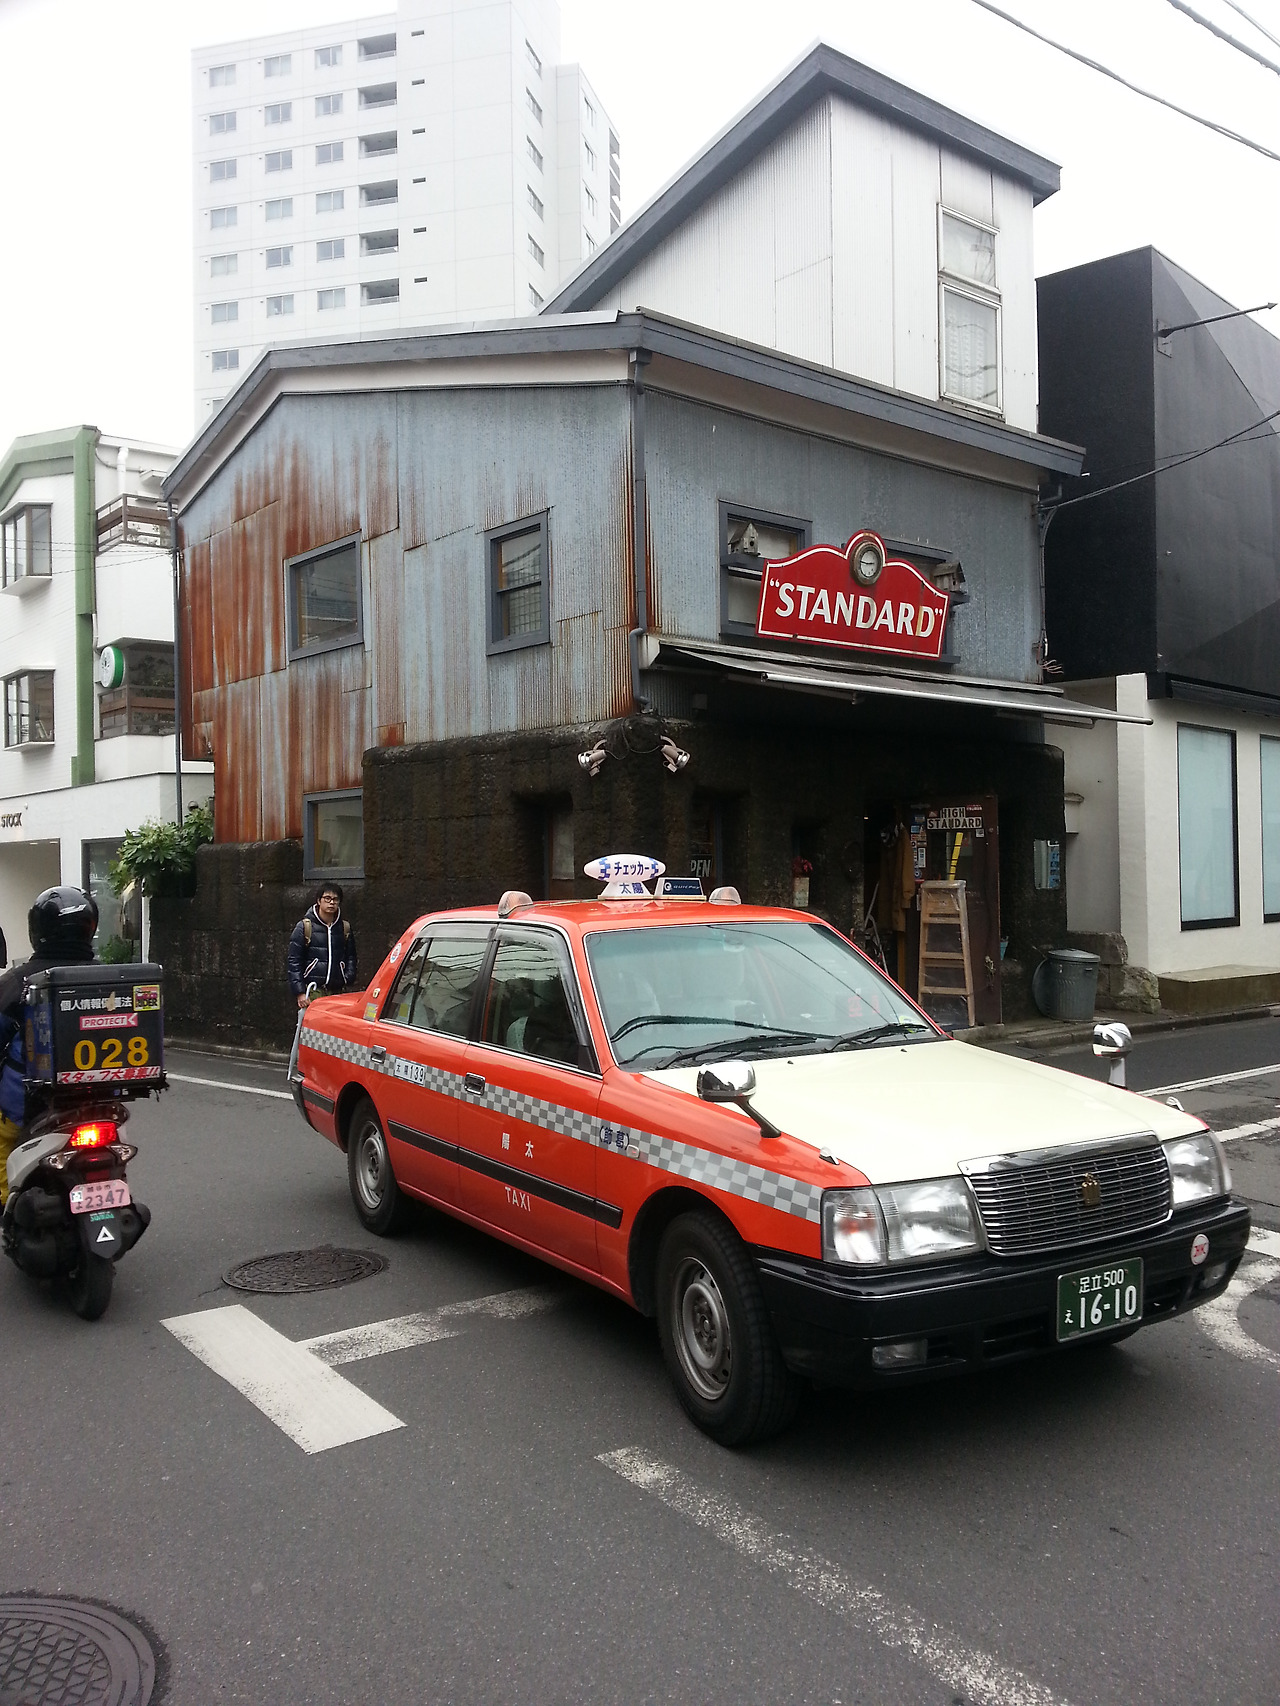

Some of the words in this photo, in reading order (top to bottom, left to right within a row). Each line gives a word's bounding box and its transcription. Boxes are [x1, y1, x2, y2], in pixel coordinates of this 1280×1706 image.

[1, 812, 22, 828] STOCK
[941, 807, 965, 818] HIGH
[928, 818, 981, 829] STANDARD
[614, 861, 650, 876] チェッカー
[619, 882, 644, 894] 太陽
[84, 1016, 125, 1027] PROTECT
[74, 1037, 149, 1070] 028
[410, 1065, 424, 1082] 139
[85, 1188, 125, 1209] 2347
[504, 1186, 531, 1212] TAXI
[1078, 1274, 1102, 1294] 足立
[1103, 1268, 1125, 1288] 500
[1064, 1310, 1074, 1324] え
[1079, 1285, 1137, 1329] 16-10
